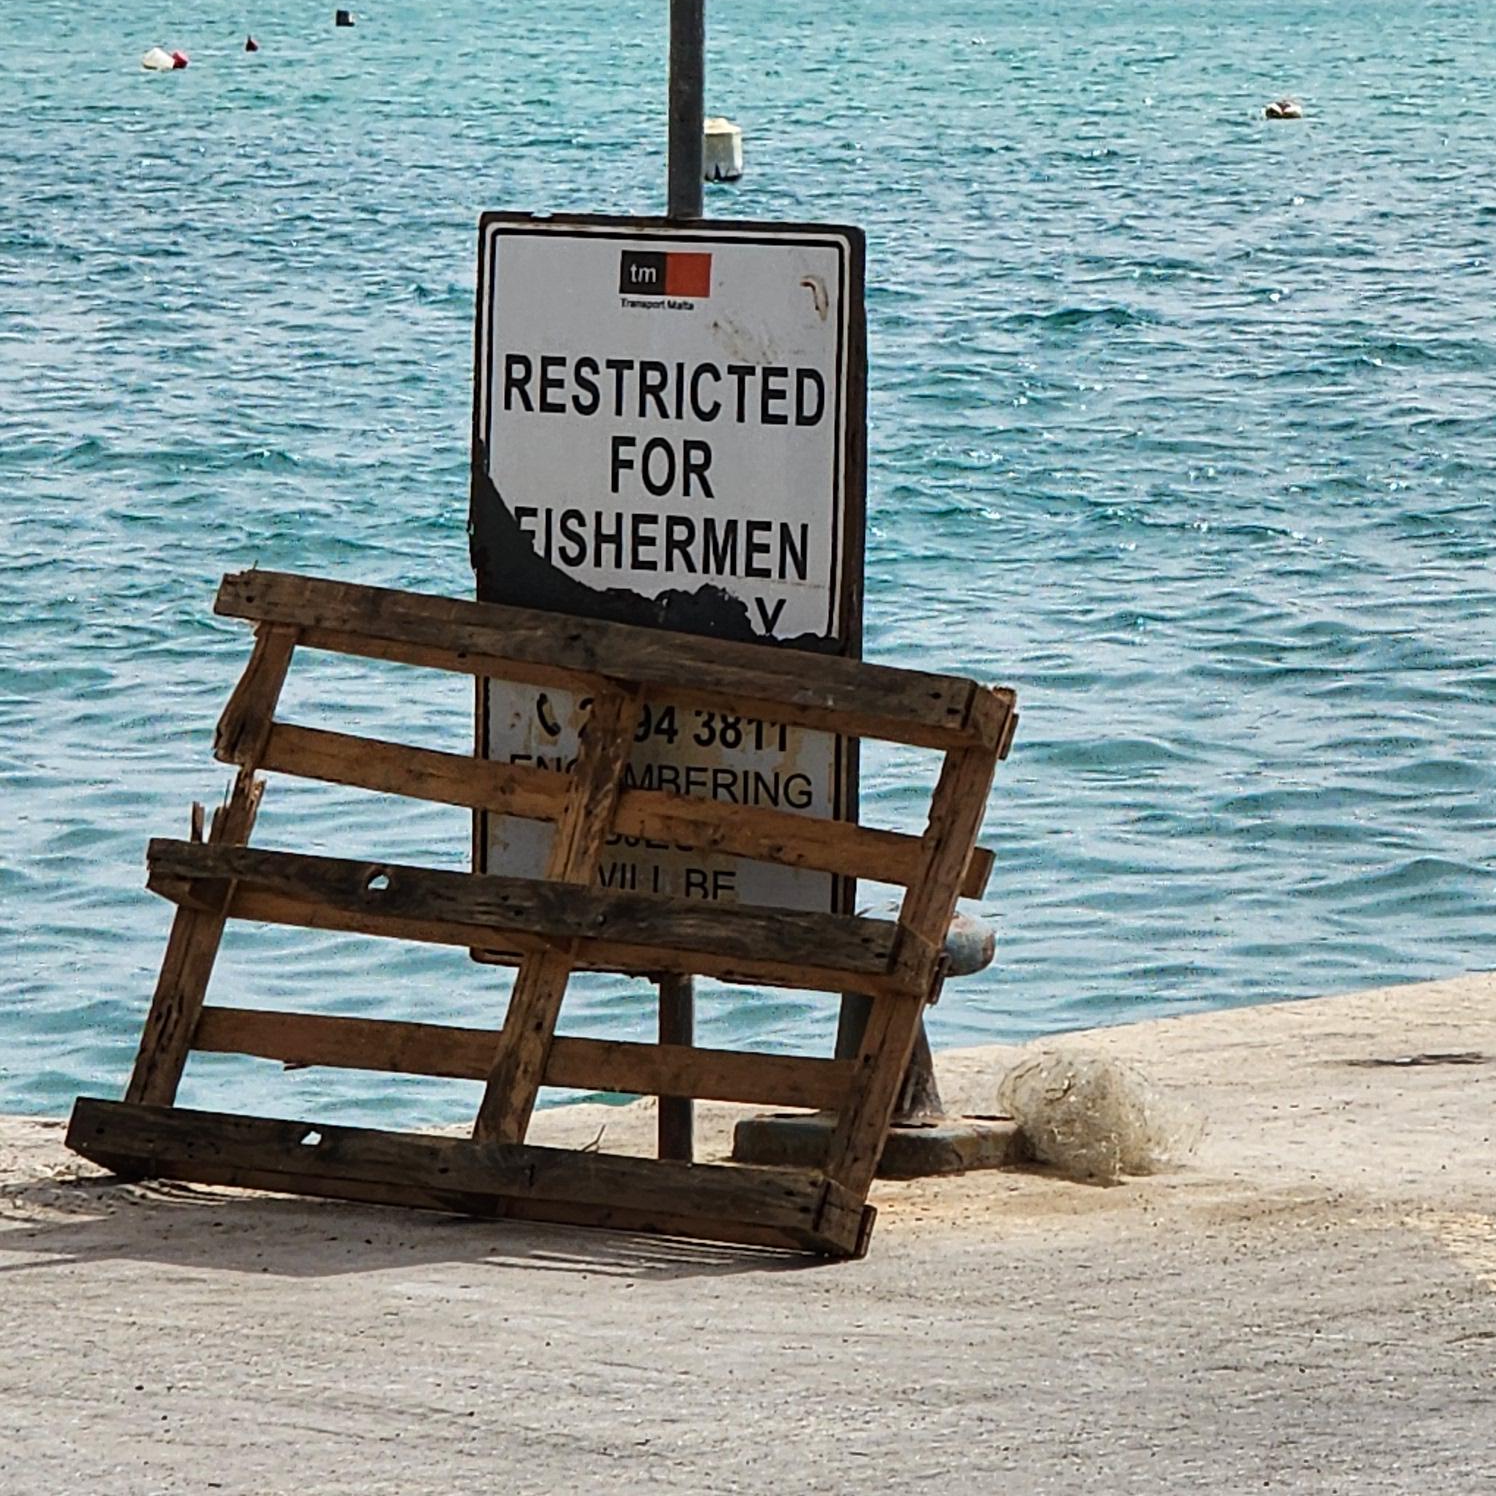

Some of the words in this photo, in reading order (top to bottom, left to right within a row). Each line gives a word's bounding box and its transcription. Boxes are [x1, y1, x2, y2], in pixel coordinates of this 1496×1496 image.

[630, 264, 657, 283] tm
[621, 298, 666, 310] Transport
[667, 300, 695, 311] Malta
[504, 353, 826, 427] RESTRICTED
[611, 435, 715, 499] FOR
[693, 710, 787, 752] 3811
